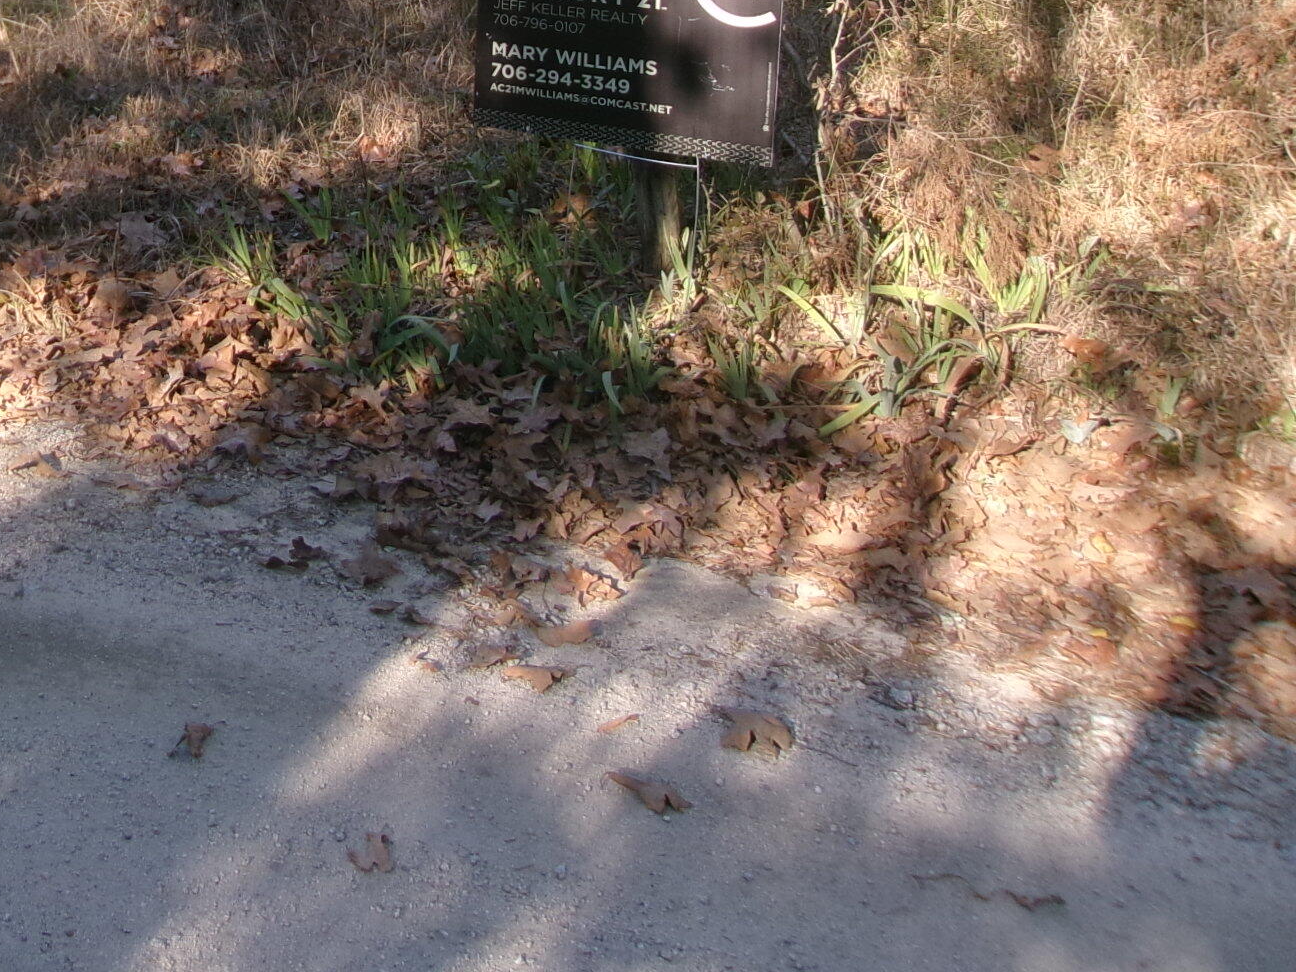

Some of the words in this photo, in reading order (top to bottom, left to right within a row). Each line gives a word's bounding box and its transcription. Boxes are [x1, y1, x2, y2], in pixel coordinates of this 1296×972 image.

[493, 13, 586, 34] 706-796-0107
[531, 2, 586, 19] KELLER
[591, 9, 648, 25] REALTY
[491, 41, 548, 62] MARY
[555, 50, 658, 76] WILLIAMS
[491, 63, 630, 94] 706-294-3349
[490, 83, 672, 115] AC21MWILLIAMS@COMCAST.NET
